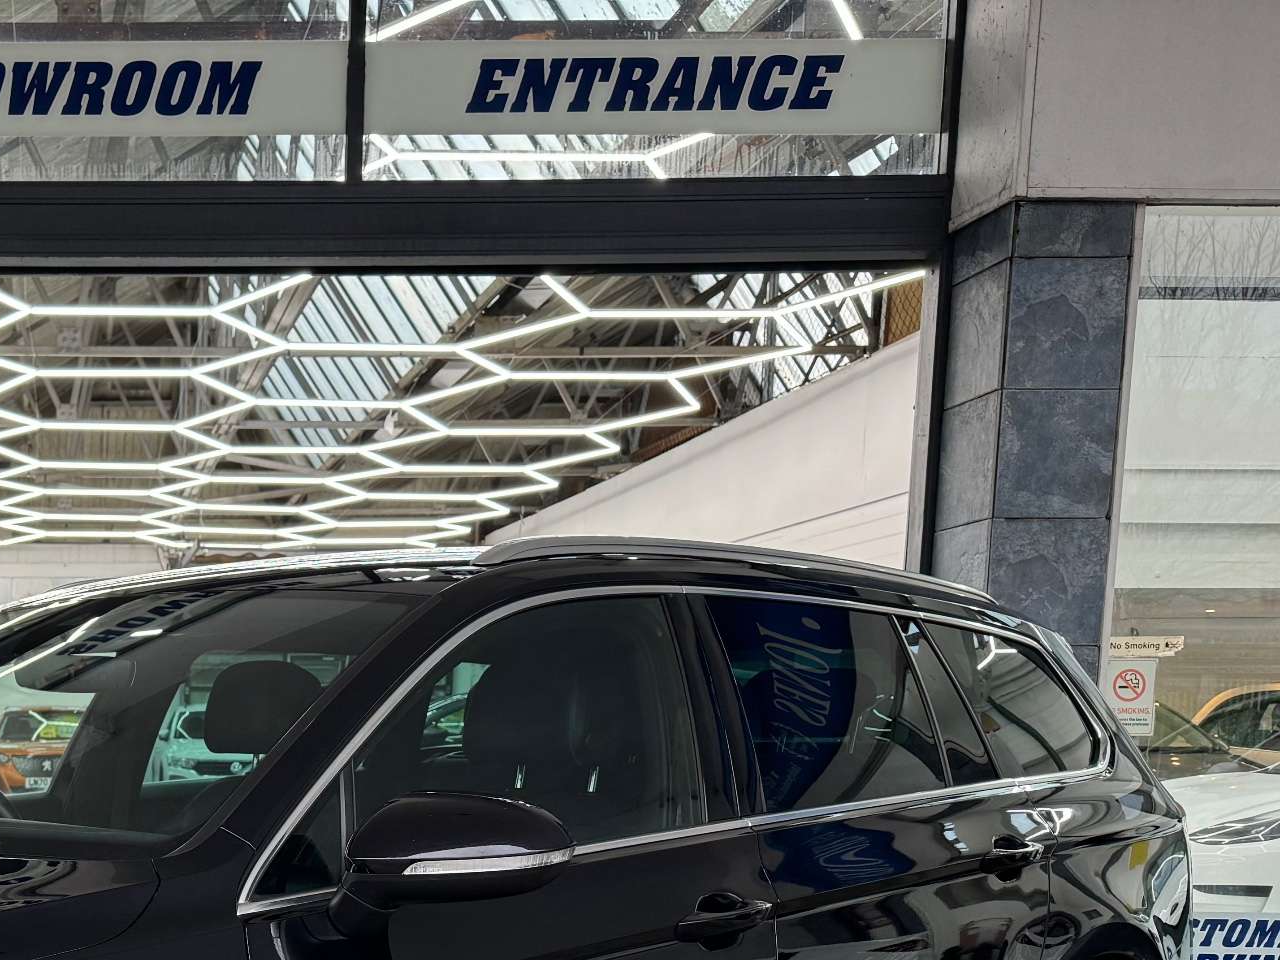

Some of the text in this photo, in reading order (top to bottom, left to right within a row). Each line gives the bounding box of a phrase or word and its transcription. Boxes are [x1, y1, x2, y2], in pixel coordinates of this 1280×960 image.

[465, 54, 845, 115] ENTRANCE
[1109, 641, 1161, 651] No Smoking
[1192, 918, 1280, 948] TOM
